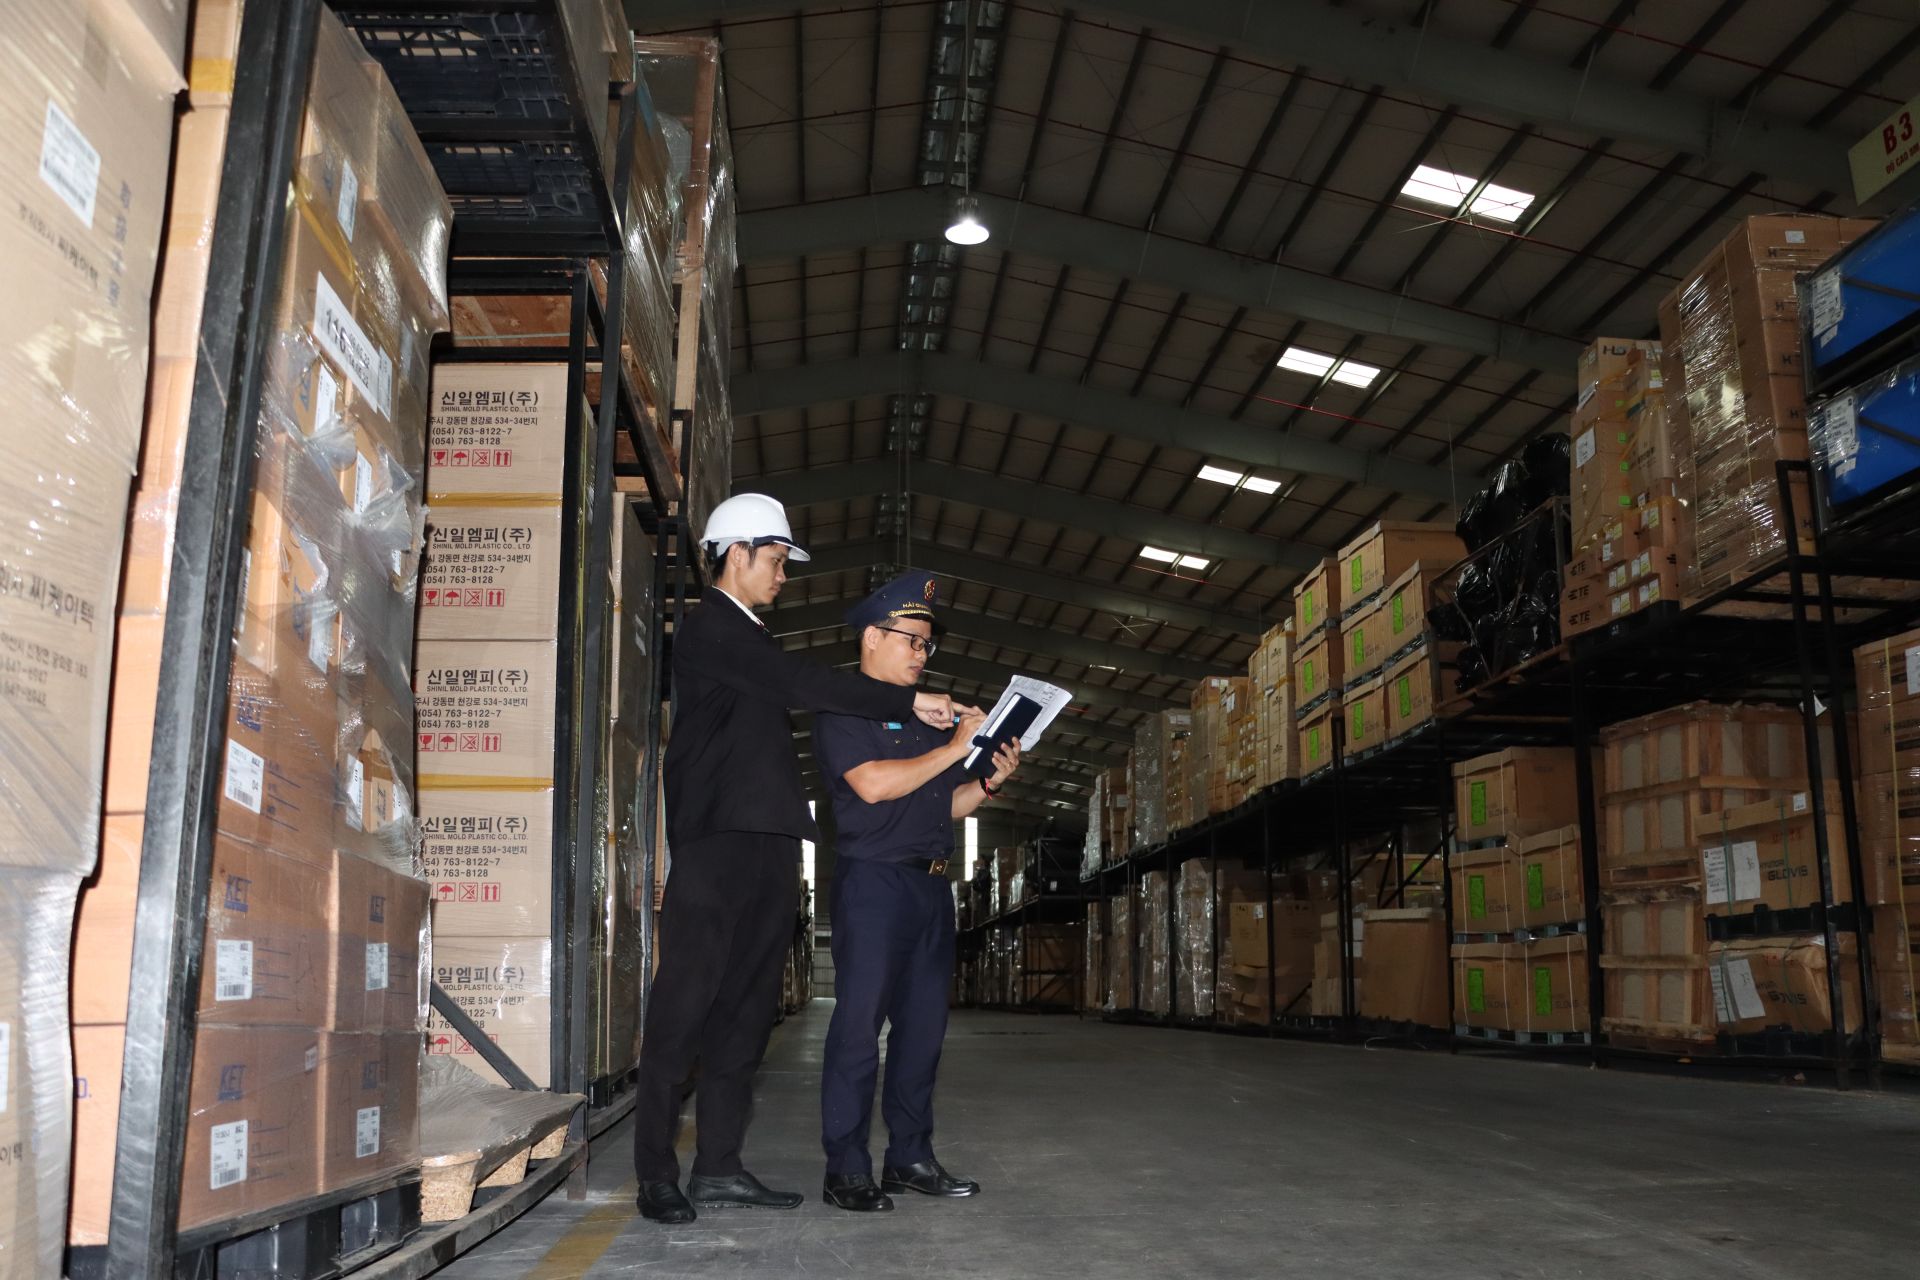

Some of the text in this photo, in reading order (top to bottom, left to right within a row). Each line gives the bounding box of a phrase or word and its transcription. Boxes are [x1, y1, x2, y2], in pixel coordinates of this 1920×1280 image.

[441, 390, 539, 406] 신일엠피(주)
[432, 428, 455, 436] (054)
[431, 437, 455, 445] (054)
[433, 527, 532, 543] 신일엠피(주)
[423, 576, 446, 584] (054)
[427, 669, 529, 686] 신일엠피(주)
[417, 709, 501, 718] (054) 763-8122~7
[417, 720, 490, 729] (054) 763-8128
[424, 816, 528, 833] 신일엠피(주)
[443, 858, 501, 866] 763-8122~7
[443, 869, 488, 877] 763-8128
[1768, 865, 1809, 881] GLOVIS
[431, 967, 525, 984] 일엠피(주)
